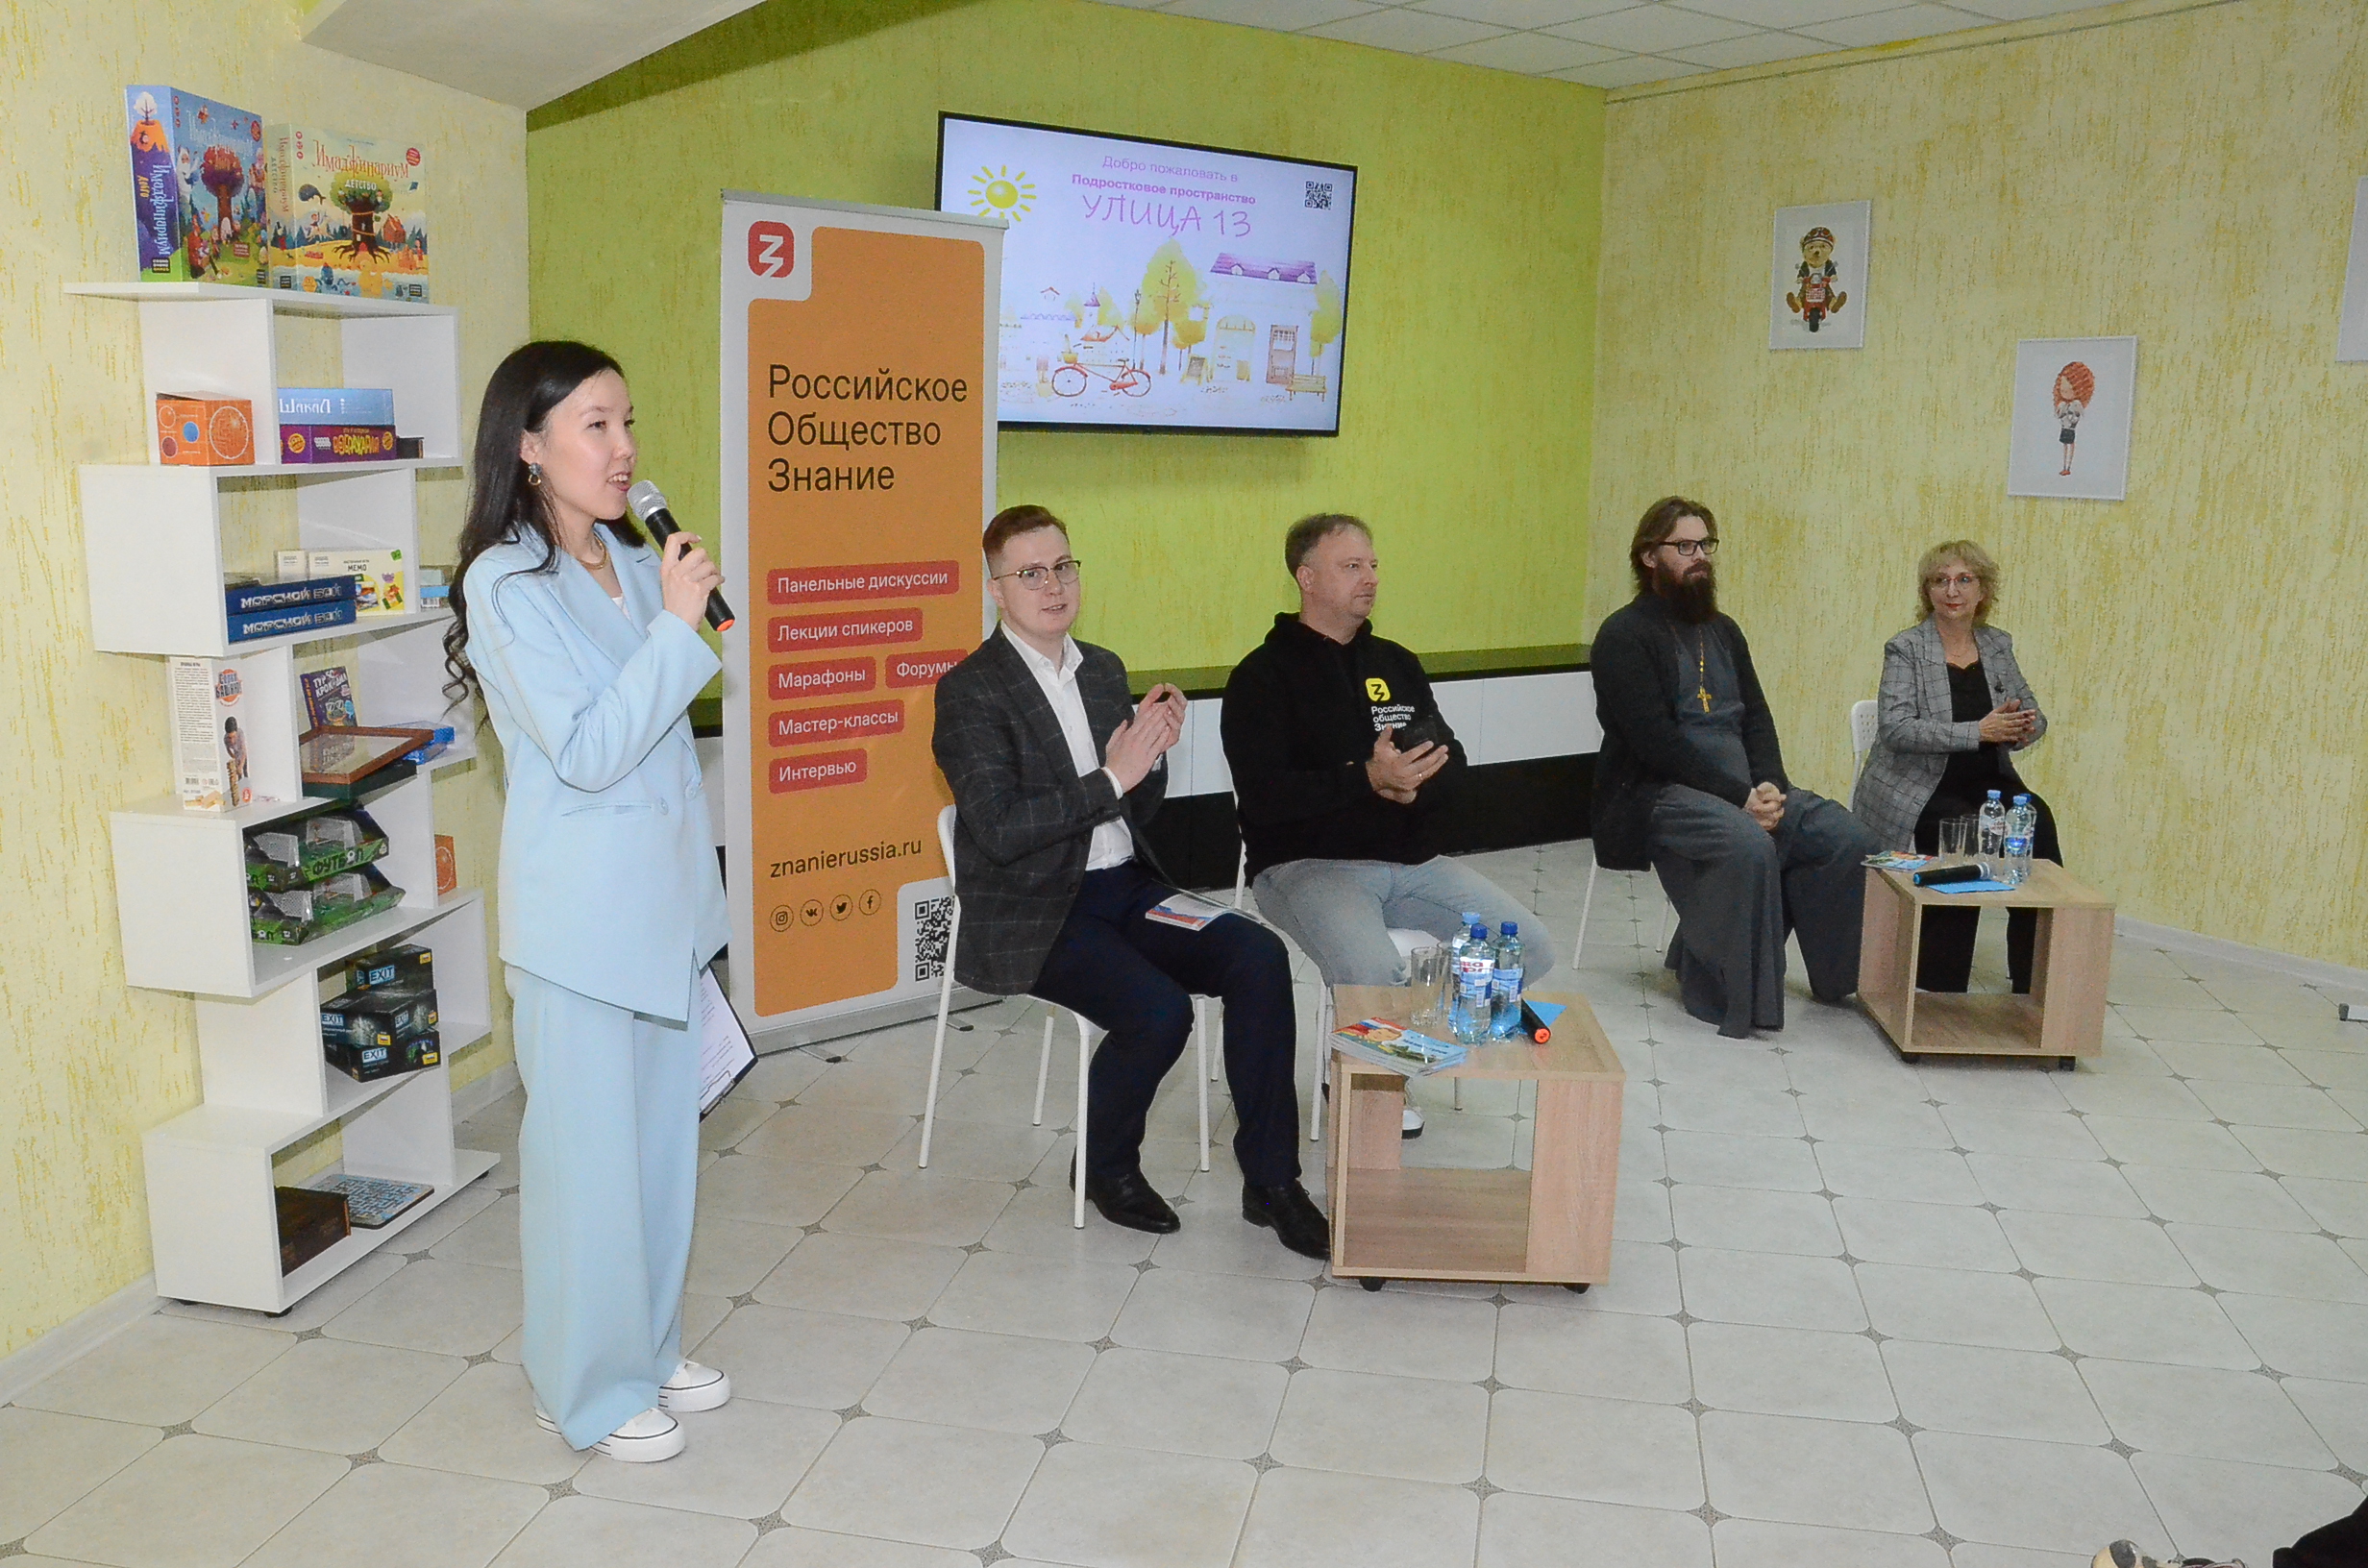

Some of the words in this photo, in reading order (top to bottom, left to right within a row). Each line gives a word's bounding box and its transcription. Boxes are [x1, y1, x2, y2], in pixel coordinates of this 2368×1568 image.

[313, 139, 408, 181] Имаджинариум
[1102, 156, 1147, 172] Добро
[1150, 163, 1227, 182] пожаловать
[345, 179, 377, 191] ДЕТСТВО
[1072, 174, 1167, 194] Подростковое
[1170, 186, 1256, 205] пространство
[150, 162, 174, 256] Имаджинариум
[1082, 194, 1201, 236] УЛИЦА
[1213, 209, 1251, 237] 13
[769, 363, 968, 402] Российское
[768, 411, 941, 451] Общество
[768, 457, 895, 492] Знание
[777, 577, 865, 594] Панельные
[868, 573, 948, 590] дискуссии
[240, 587, 310, 608] МОРСКОЙ
[243, 612, 312, 634] МОРСКОЙ
[777, 625, 838, 642] Лекции
[842, 620, 913, 637] спикеров
[778, 669, 865, 690] Марафоны
[1370, 703, 1416, 715] Российское
[1372, 713, 1412, 723] общество
[778, 711, 899, 736] Мастер-классы
[1374, 722, 1407, 732] Знние
[778, 761, 856, 782] Интервью
[770, 840, 922, 878] znanierussia.ru
[370, 967, 393, 982] EXIT
[322, 1015, 344, 1025] EXIT
[363, 1048, 385, 1060] EXIT
